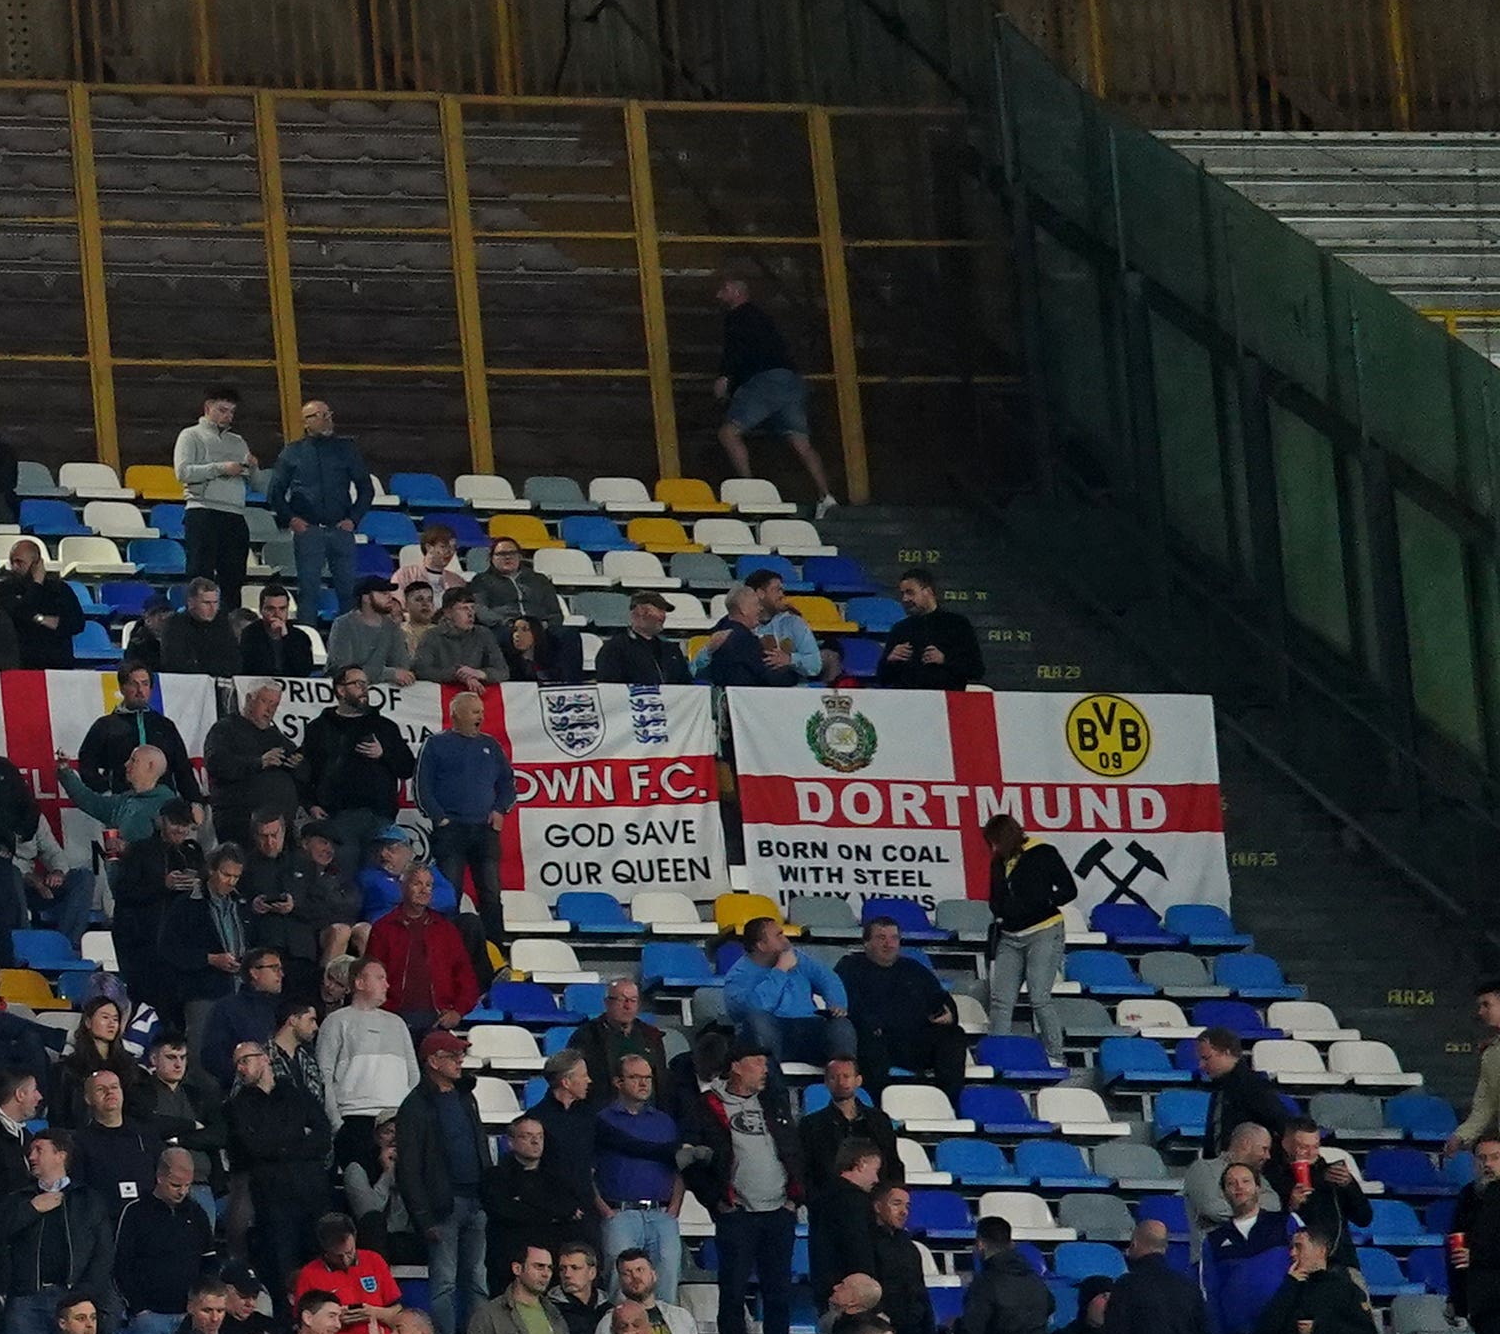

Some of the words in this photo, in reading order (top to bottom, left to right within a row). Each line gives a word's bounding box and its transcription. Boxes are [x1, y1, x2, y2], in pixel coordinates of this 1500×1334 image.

[274, 678, 336, 704] PRID
[1078, 701, 1141, 752] BVB
[1099, 751, 1123, 770] 09
[629, 762, 708, 801] F.C.
[795, 780, 1168, 831] DORTMUND
[545, 822, 614, 848] GOD
[625, 819, 697, 846] SAVE
[757, 839, 828, 860] BORN
[837, 843, 876, 861] ON
[882, 845, 950, 864] COAL
[540, 861, 603, 886] OUR
[611, 856, 712, 885] QUEEN
[778, 865, 843, 884] WITH
[854, 868, 932, 888] STEEL
